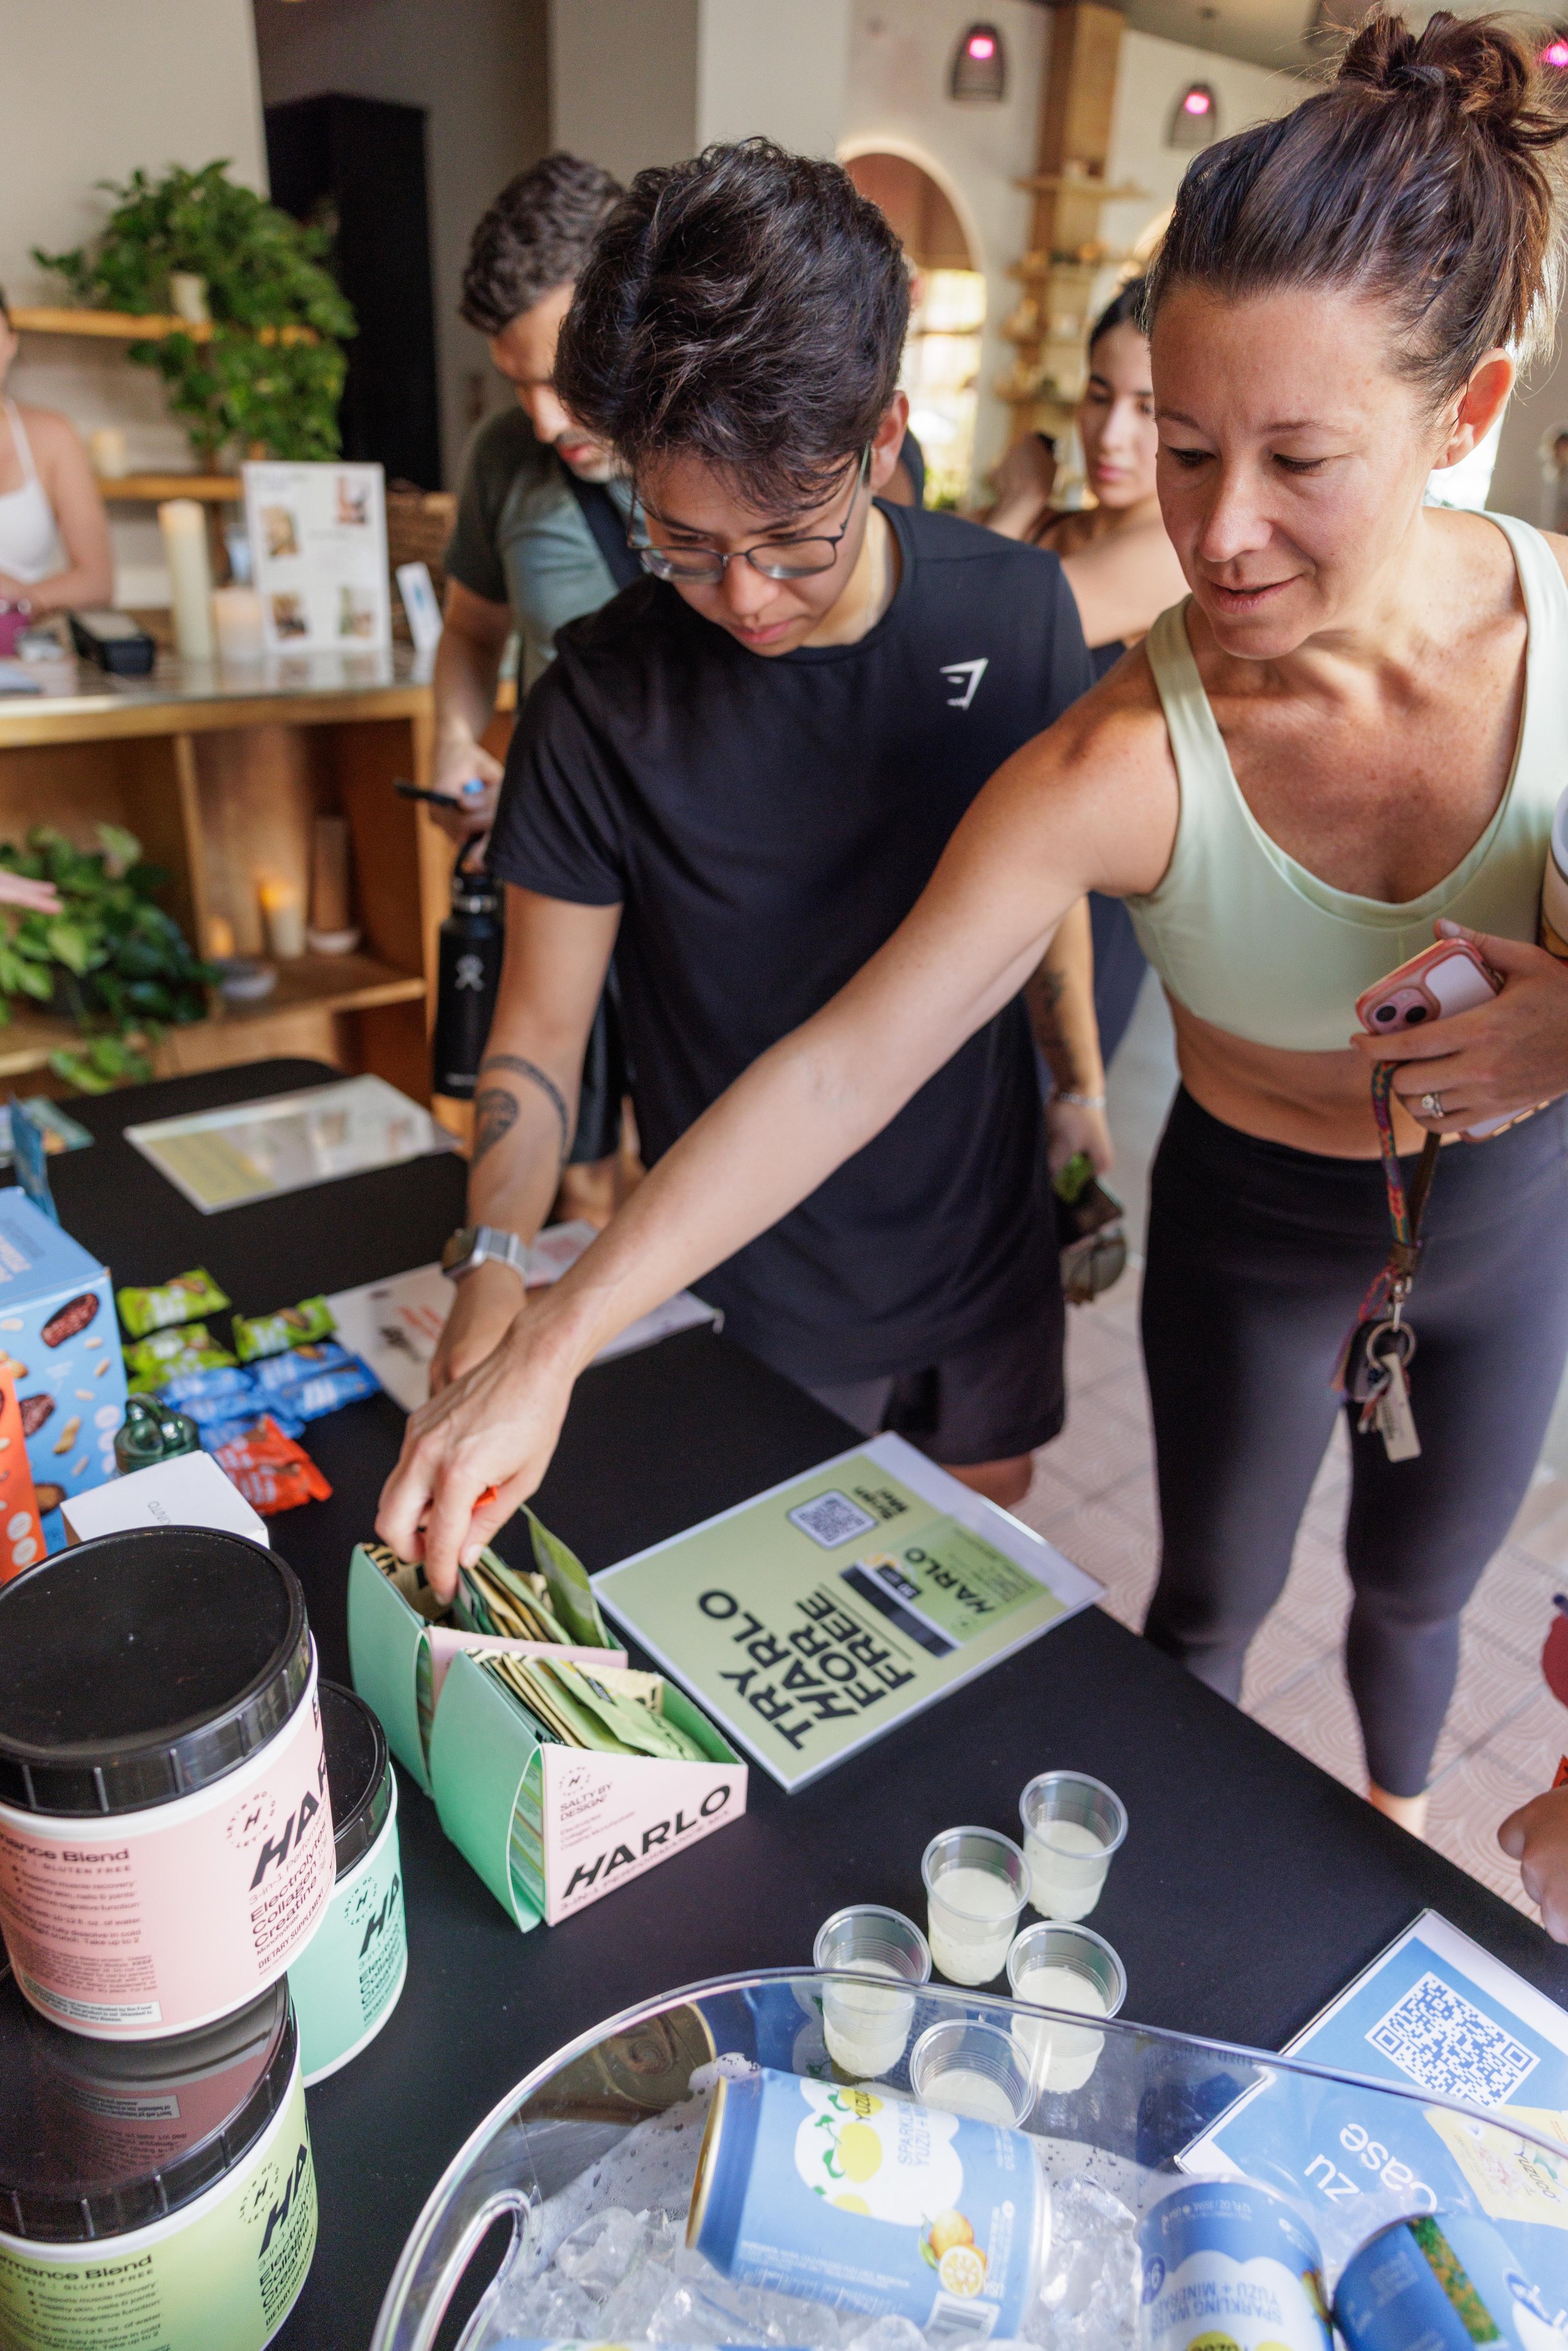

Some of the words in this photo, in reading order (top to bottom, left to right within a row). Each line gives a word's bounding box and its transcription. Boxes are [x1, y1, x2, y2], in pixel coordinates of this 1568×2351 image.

[905, 1547, 995, 1613] HARLO
[698, 1589, 859, 1720] HARLO
[788, 1625, 887, 1708] FOR
[795, 1591, 916, 1690] FREE
[719, 1668, 813, 1750] TRY
[560, 1790, 596, 1812] SALTY
[598, 1782, 613, 1795] BY
[63, 1847, 130, 1862] Blend
[97, 1864, 132, 1874] FREE
[562, 1785, 731, 1899] HARLO
[252, 1860, 317, 1934] Collagen
[254, 1876, 317, 1948] Creatine
[258, 1939, 290, 1969] DIETARY
[290, 1888, 325, 1941] SUPPLEMENT
[85, 2253, 152, 2279] Blend
[120, 2268, 154, 2283] FREE
[1237, 2282, 1278, 2305] YUZU
[266, 2290, 291, 2327] DIETARY
[1194, 2297, 1282, 2326] SPARKLING
